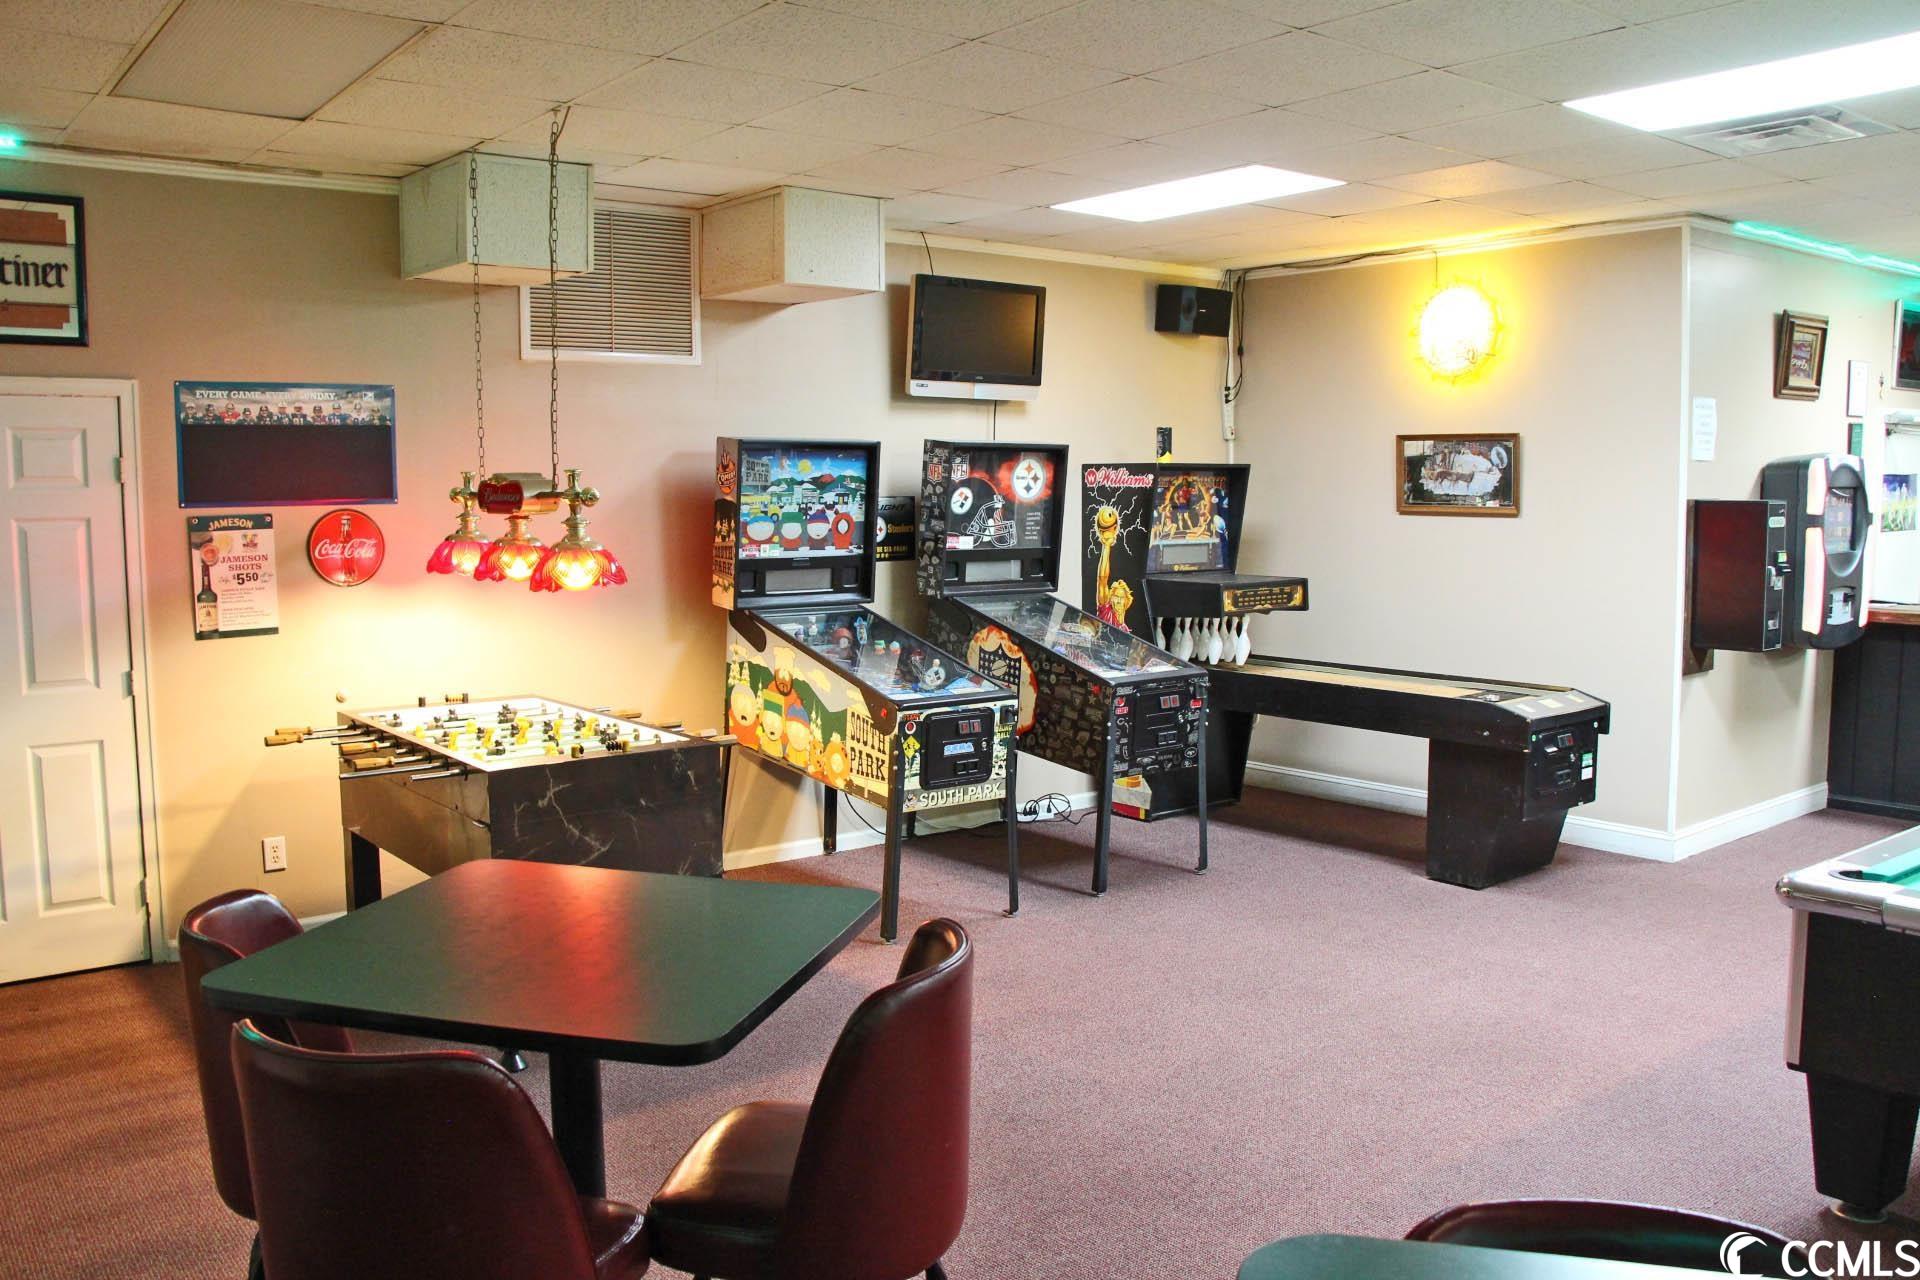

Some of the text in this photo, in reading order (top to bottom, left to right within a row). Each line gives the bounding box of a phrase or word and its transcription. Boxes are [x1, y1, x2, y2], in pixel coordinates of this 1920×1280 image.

[195, 390, 229, 399] EVERY
[745, 472, 769, 483] PARK
[952, 463, 967, 478] NFL
[1100, 467, 1154, 488] Williams
[208, 518, 253, 531] JAMESON
[220, 554, 268, 564] JAMESON
[228, 562, 262, 572] SHOTS
[850, 711, 887, 755] SOUTH
[850, 746, 886, 782] PARK
[919, 782, 1001, 808] SOUTH PARK
